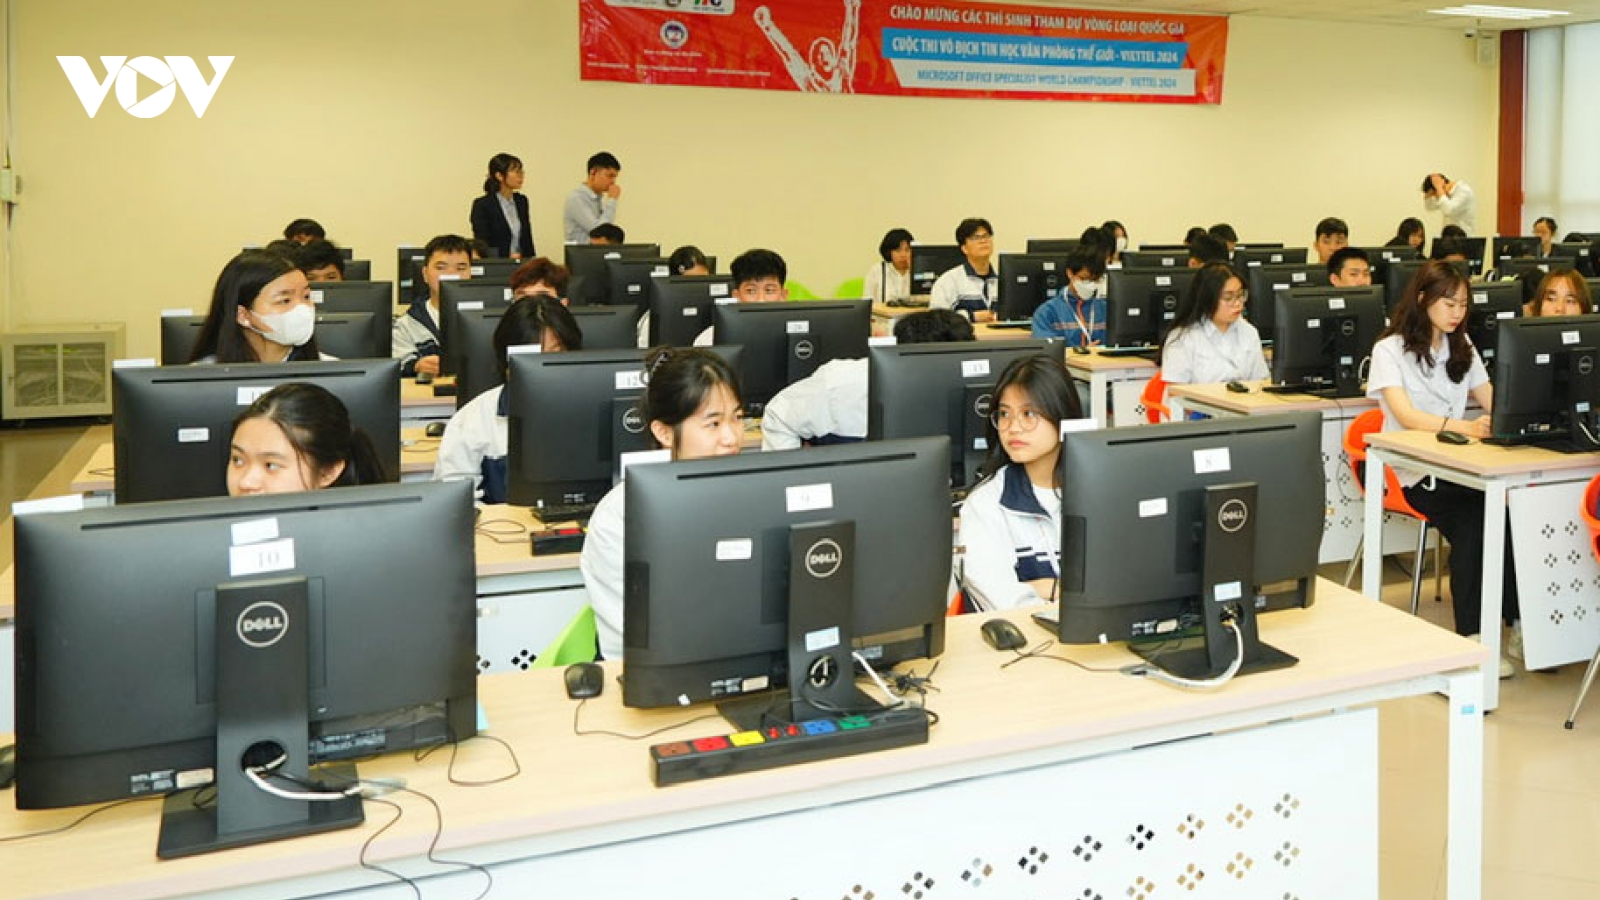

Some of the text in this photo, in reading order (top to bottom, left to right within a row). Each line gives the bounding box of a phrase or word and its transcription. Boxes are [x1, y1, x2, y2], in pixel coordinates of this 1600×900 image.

[258, 551, 280, 569] 10
[810, 552, 838, 565] DELL
[243, 616, 283, 632] DELL
